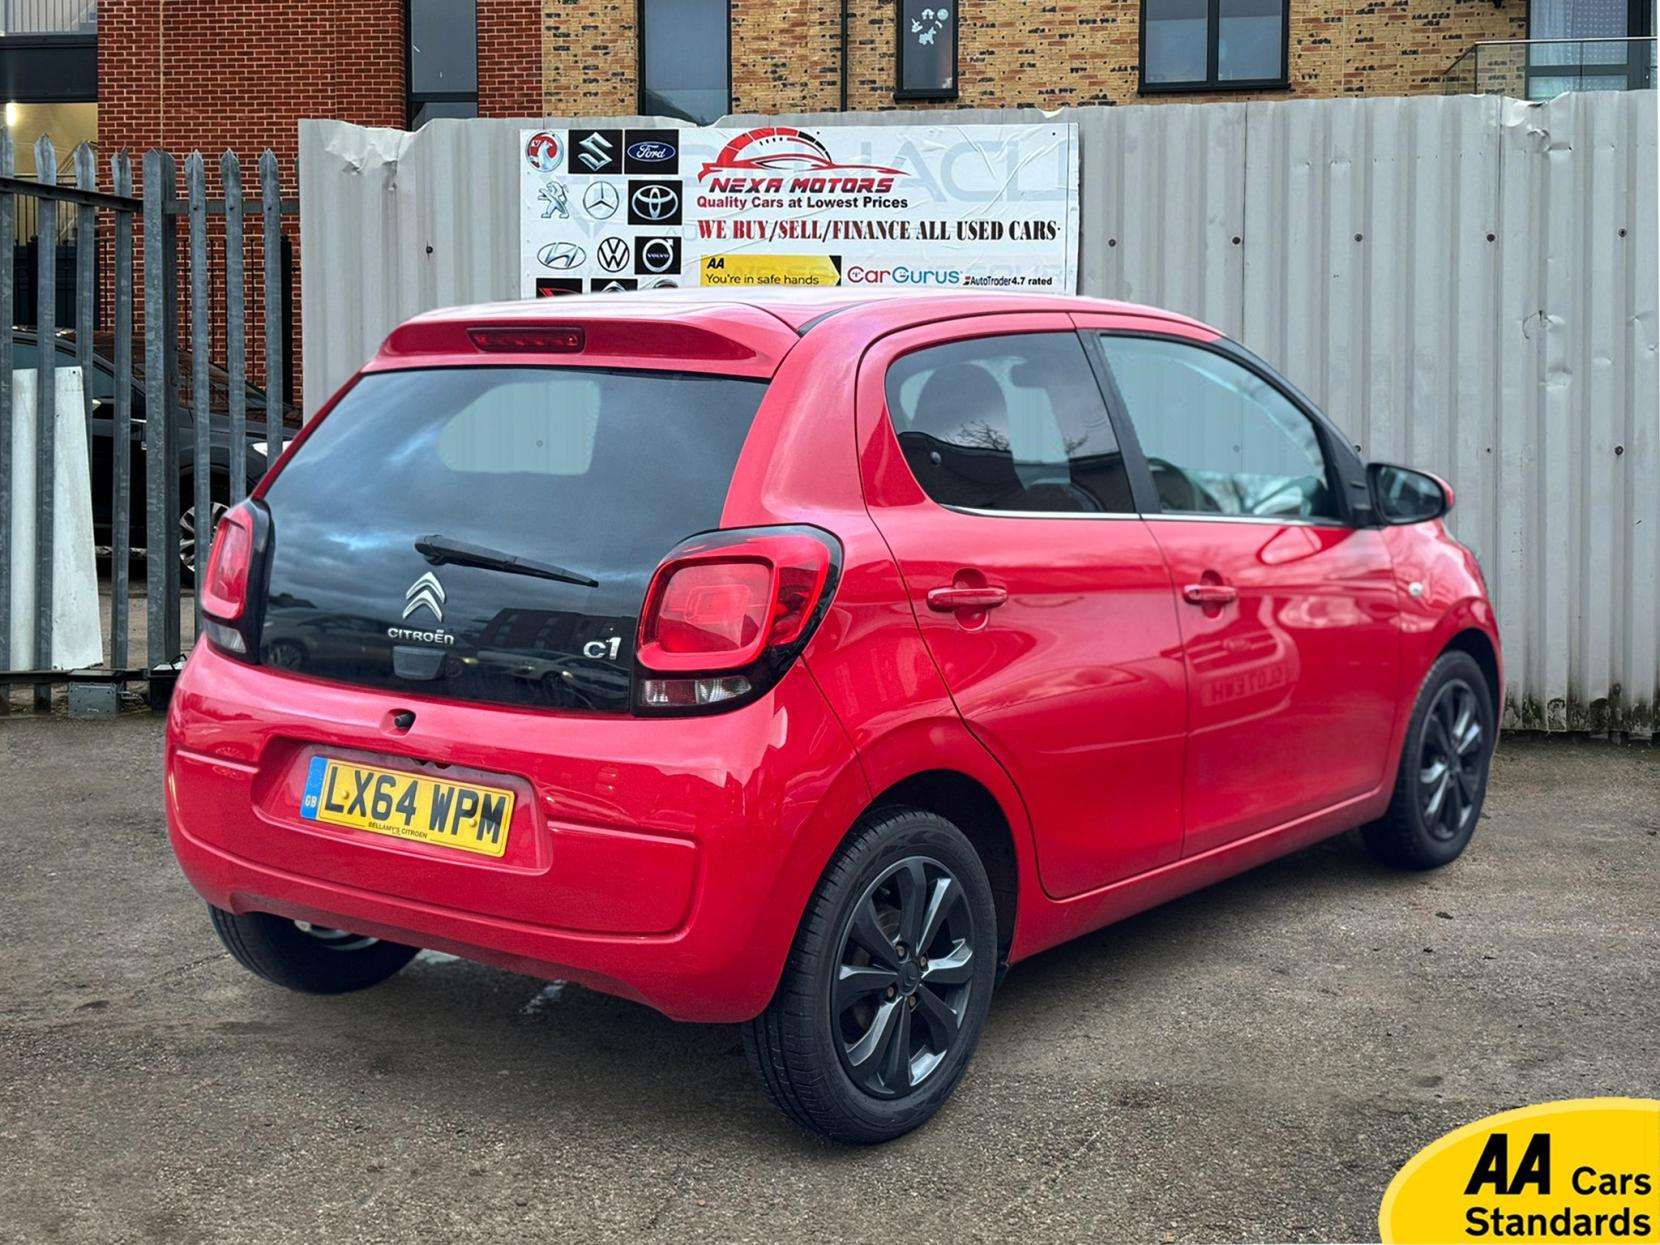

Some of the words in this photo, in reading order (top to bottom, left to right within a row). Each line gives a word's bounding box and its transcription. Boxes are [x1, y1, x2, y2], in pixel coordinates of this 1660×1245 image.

[636, 144, 667, 159] Ford
[709, 177, 784, 194] NEXA
[789, 177, 894, 194] MOTORS
[697, 196, 746, 209] Quality
[752, 196, 784, 208] Cars
[788, 197, 803, 208] at
[807, 196, 859, 208] Lowest
[863, 196, 908, 208] Prices
[698, 220, 727, 240] WE
[916, 220, 950, 240] ALL
[956, 220, 1004, 240] USED
[1008, 220, 1057, 240] CARS
[706, 258, 725, 269] AA
[705, 273, 742, 285] You're
[745, 274, 754, 284] in
[757, 273, 780, 285] safe
[783, 274, 820, 285] hands
[847, 266, 959, 284] CarGurus
[1028, 277, 1053, 286] rated
[304, 794, 317, 809] GB
[324, 766, 419, 826] LX64
[428, 784, 507, 845] WPM
